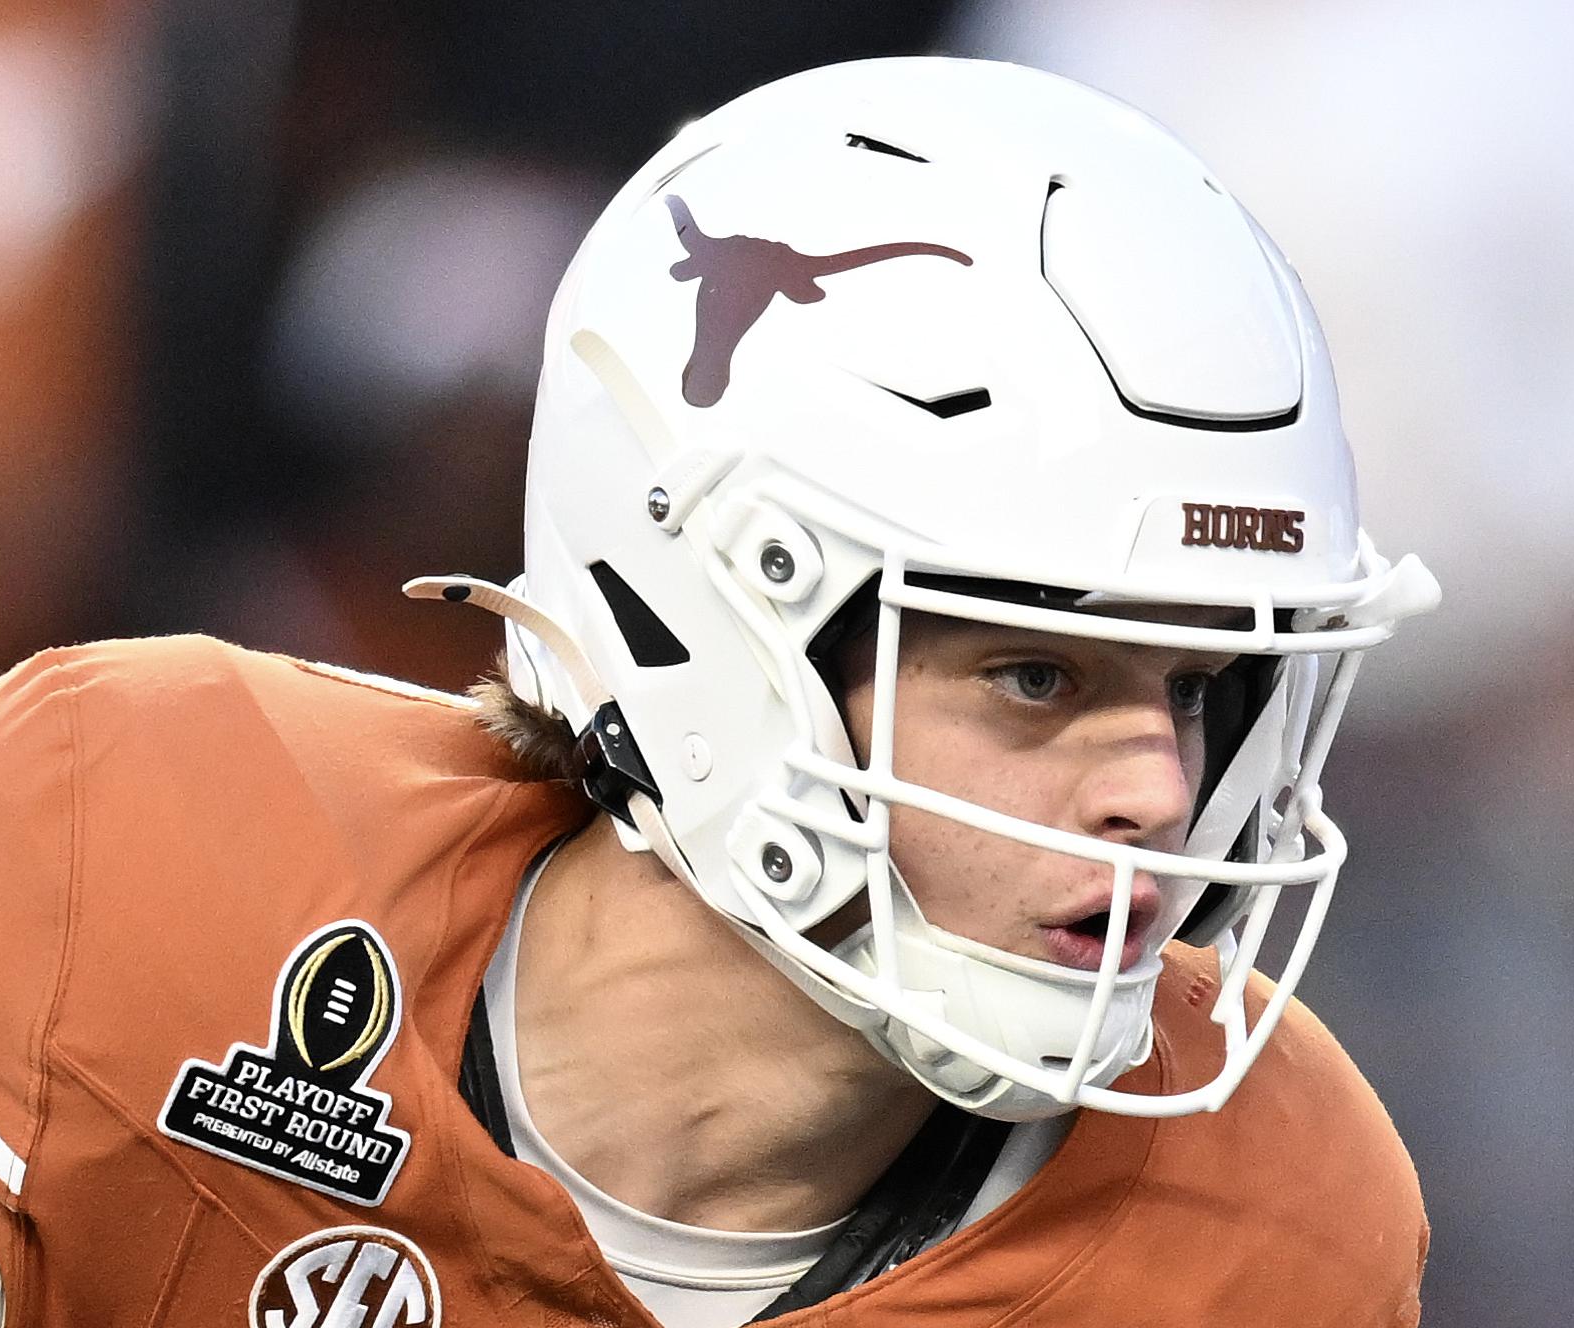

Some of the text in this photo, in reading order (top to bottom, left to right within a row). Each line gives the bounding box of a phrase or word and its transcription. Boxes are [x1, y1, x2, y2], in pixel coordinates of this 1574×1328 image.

[1181, 502, 1305, 554] HORNS
[187, 1076, 393, 1165] FIRST ROUND
[233, 1060, 374, 1126] PLAYOFF
[192, 1112, 361, 1184] PRESENTED BY Allstate
